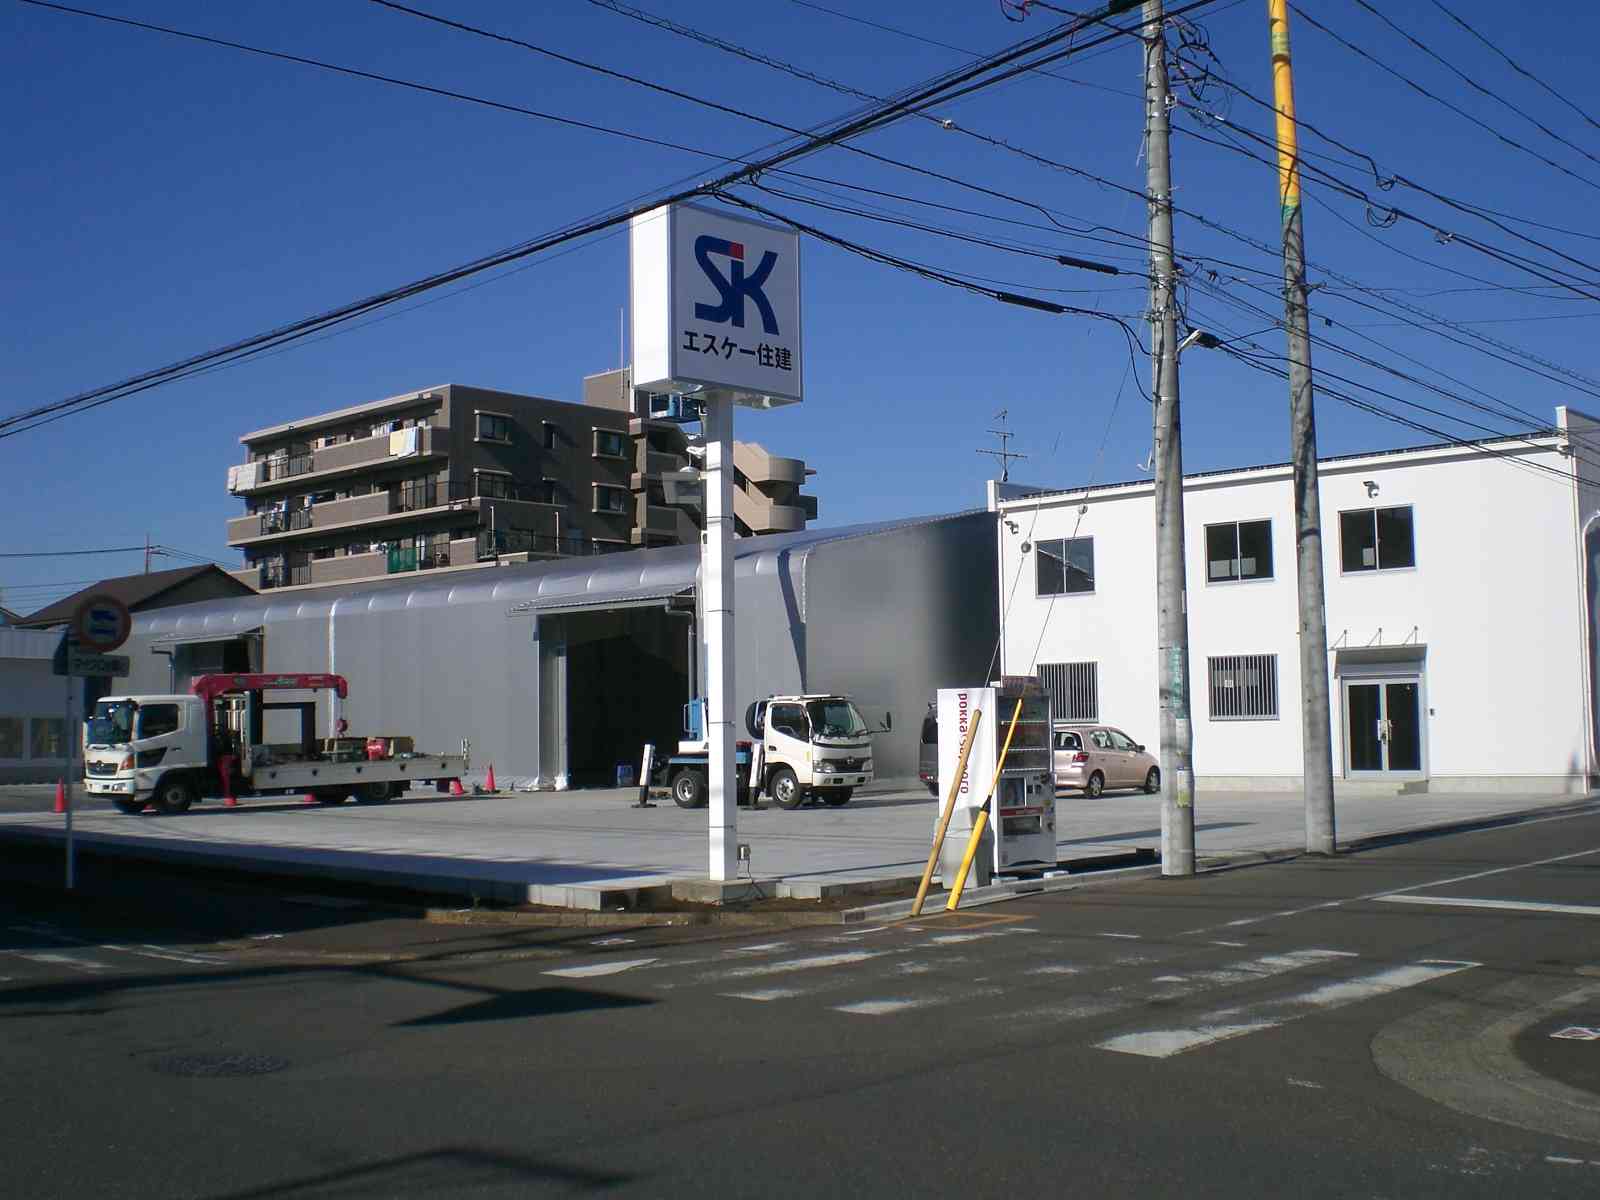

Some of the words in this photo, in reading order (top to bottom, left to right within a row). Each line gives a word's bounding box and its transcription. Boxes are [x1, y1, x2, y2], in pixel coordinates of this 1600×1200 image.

[683, 330, 792, 371] エスケー住建
